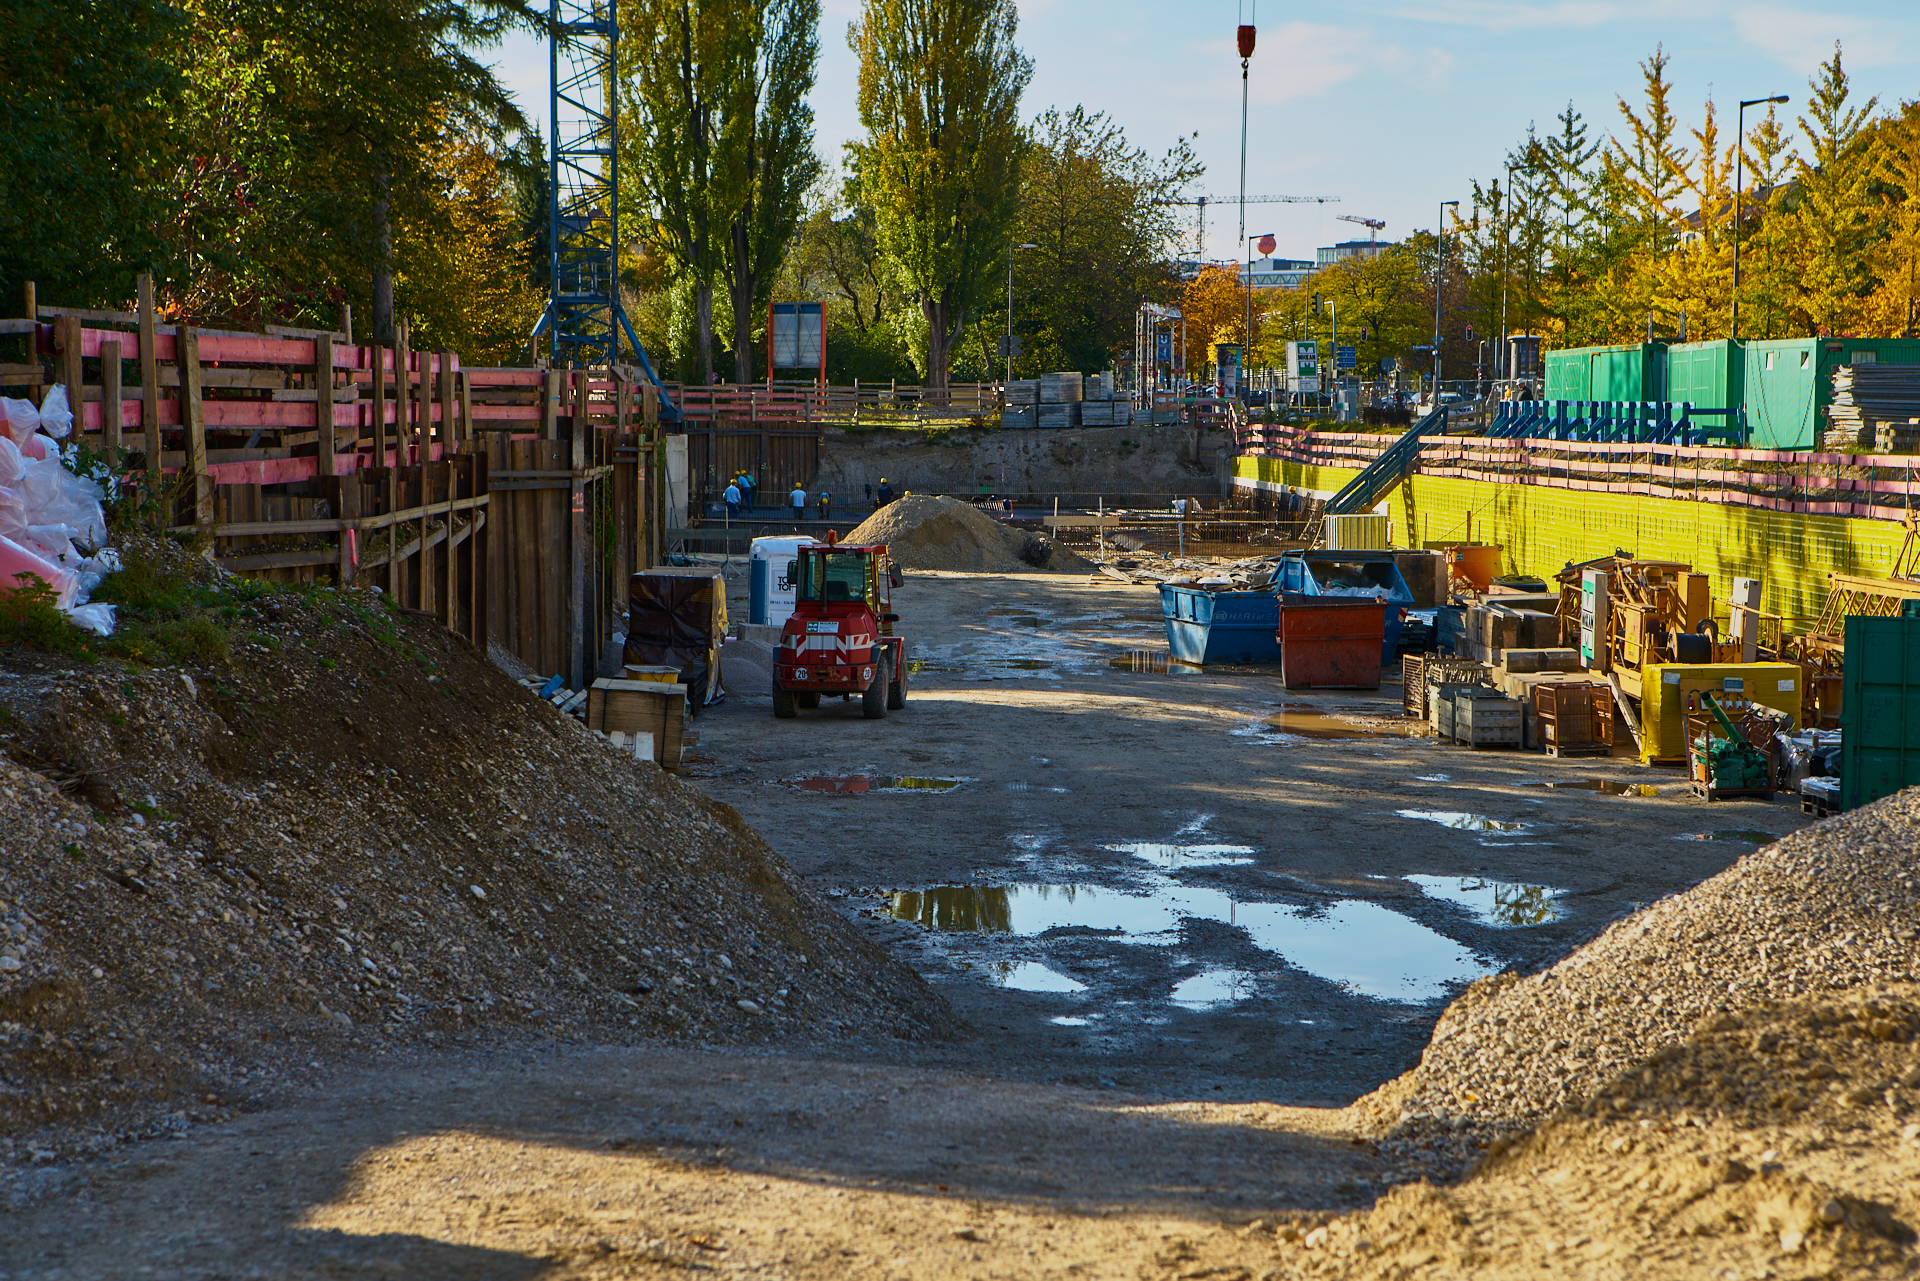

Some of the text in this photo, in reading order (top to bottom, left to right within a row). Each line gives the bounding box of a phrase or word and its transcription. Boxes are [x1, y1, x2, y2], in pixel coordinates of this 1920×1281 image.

[777, 576, 788, 584] TO
[1229, 612, 1278, 621] HARTMEI
[797, 669, 806, 679] 20
[864, 669, 871, 678] 20
